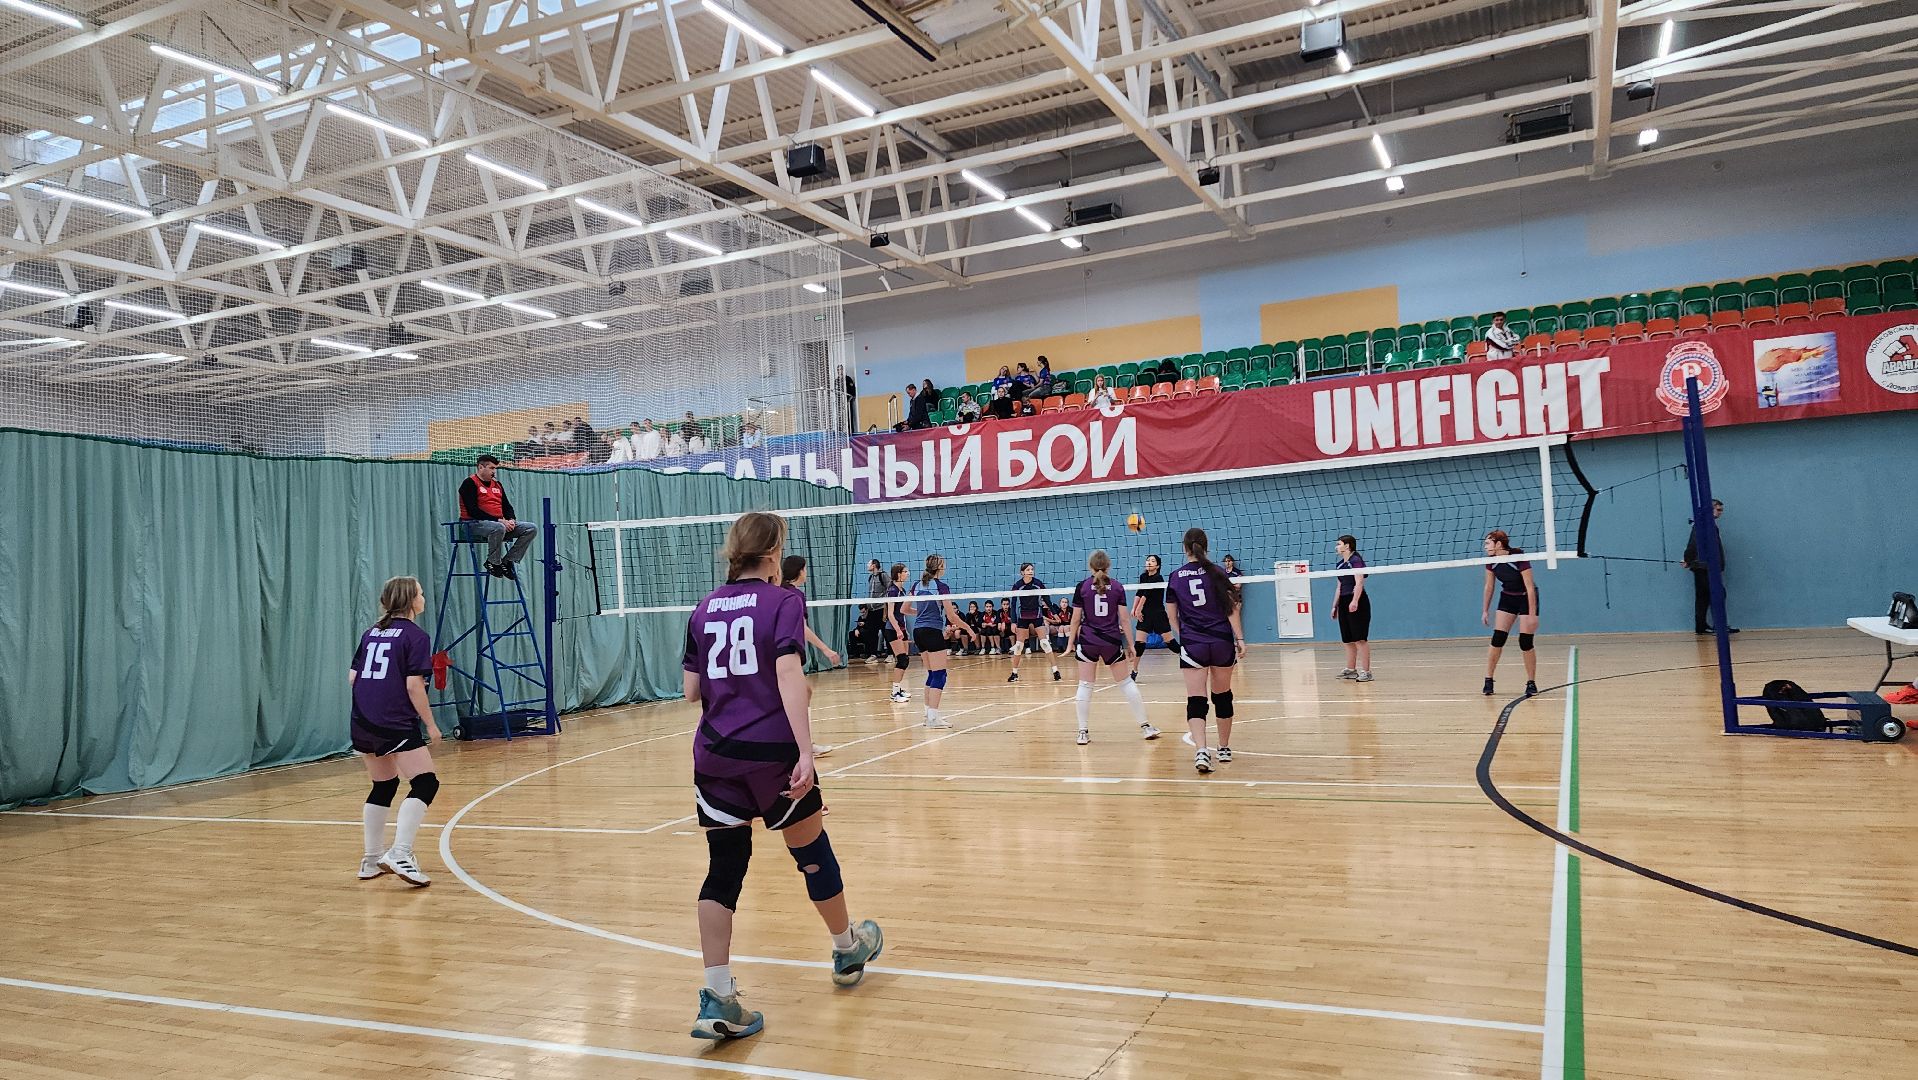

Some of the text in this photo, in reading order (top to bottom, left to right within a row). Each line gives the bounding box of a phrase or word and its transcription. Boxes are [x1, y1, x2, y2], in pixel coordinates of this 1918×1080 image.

[1312, 357, 1610, 456] UNIFIGHT
[997, 404, 1139, 489] БОЙ
[707, 592, 758, 613] ПРОНИНА
[1094, 593, 1109, 617] 6
[1188, 578, 1207, 607] 5
[361, 642, 391, 679] 15
[703, 615, 759, 680] 28
